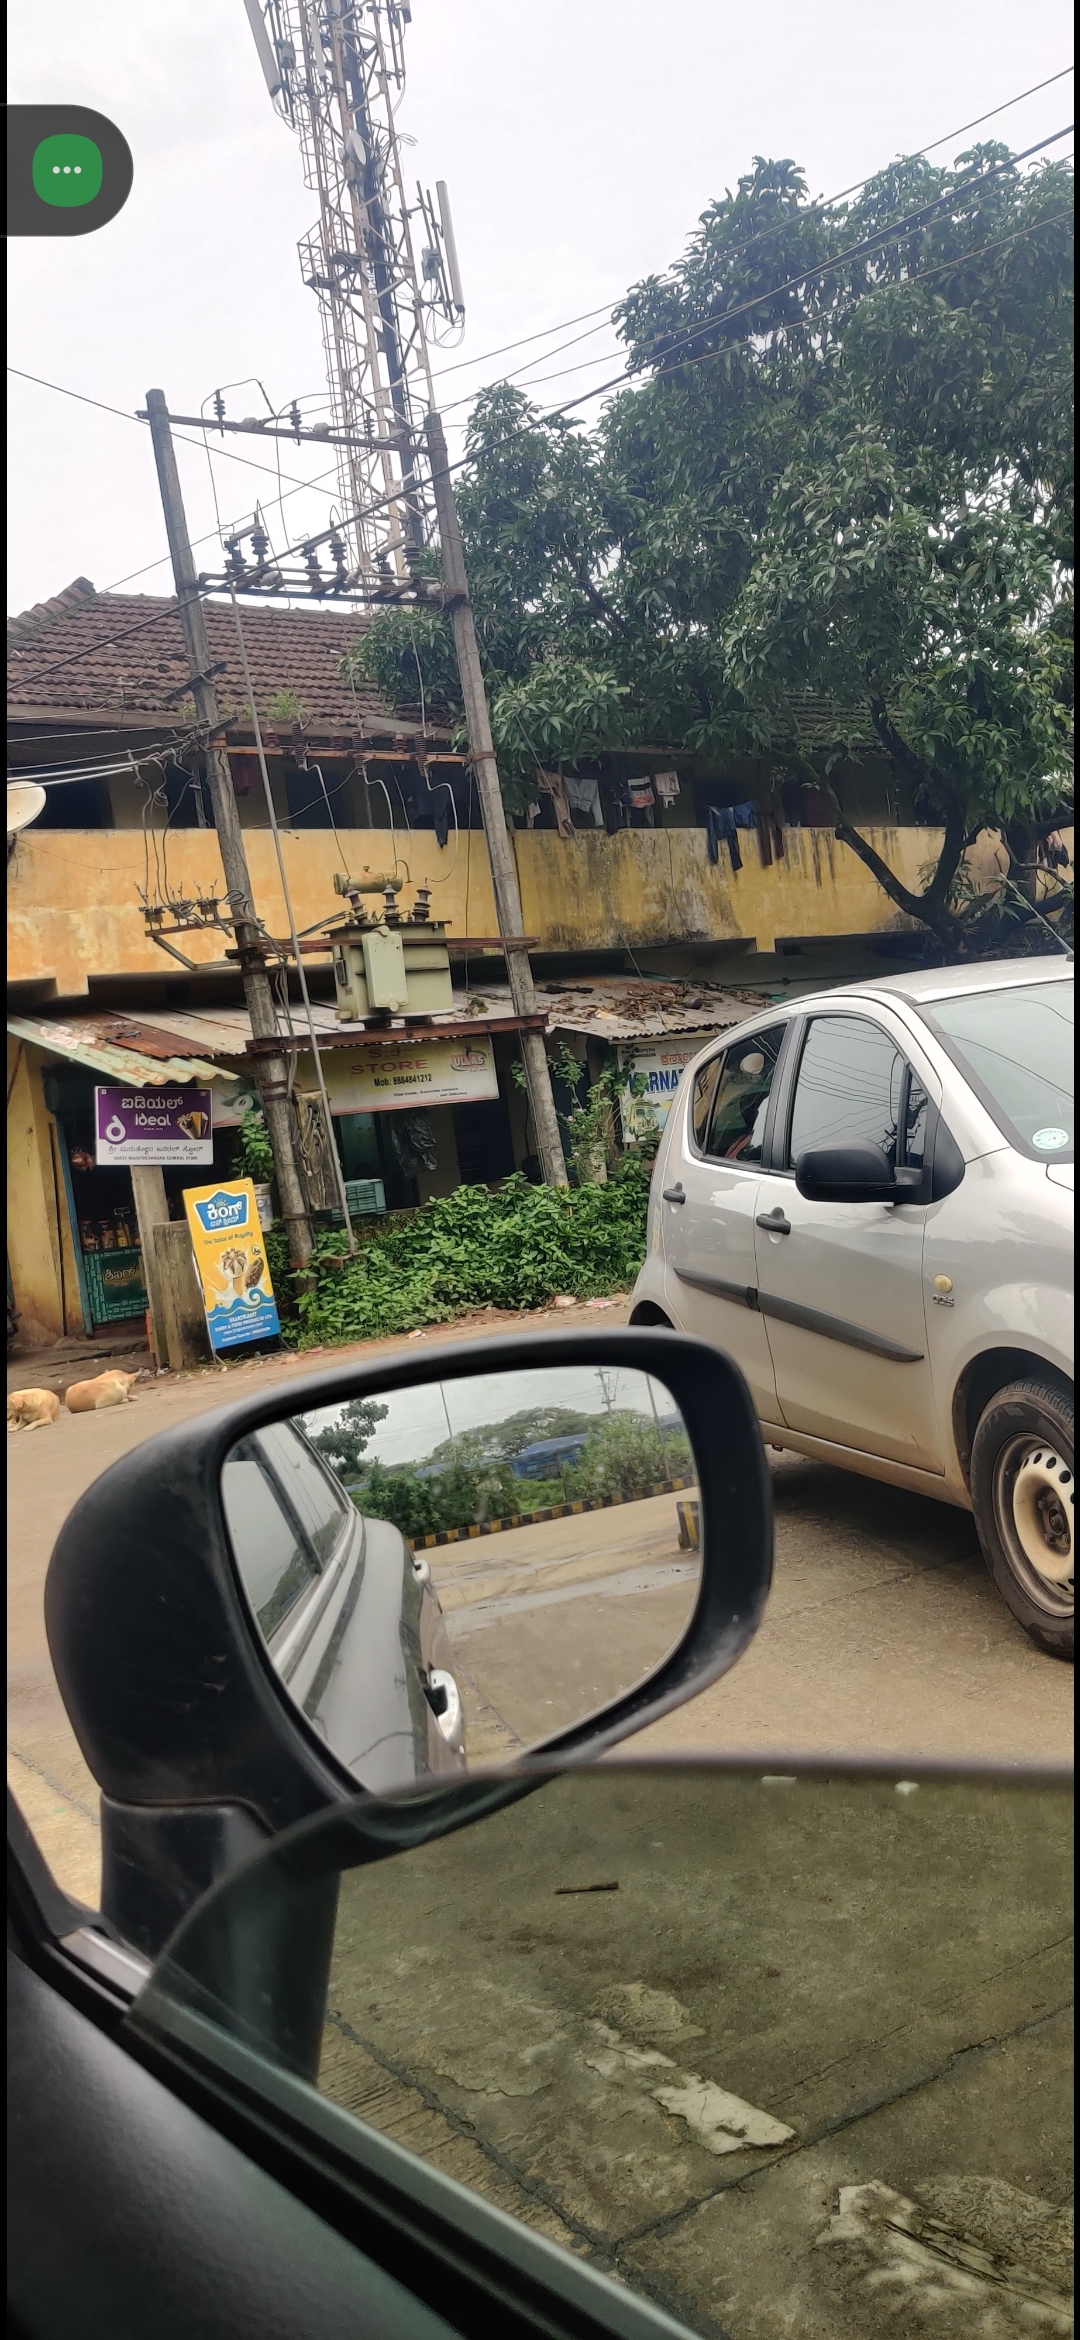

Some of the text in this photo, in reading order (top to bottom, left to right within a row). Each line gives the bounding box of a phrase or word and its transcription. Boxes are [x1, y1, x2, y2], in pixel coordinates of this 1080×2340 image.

[351, 1059, 429, 1075] STORE
[374, 1077, 392, 1087] Mob:
[121, 1095, 183, 1109] ಐಡಿಯಲ್
